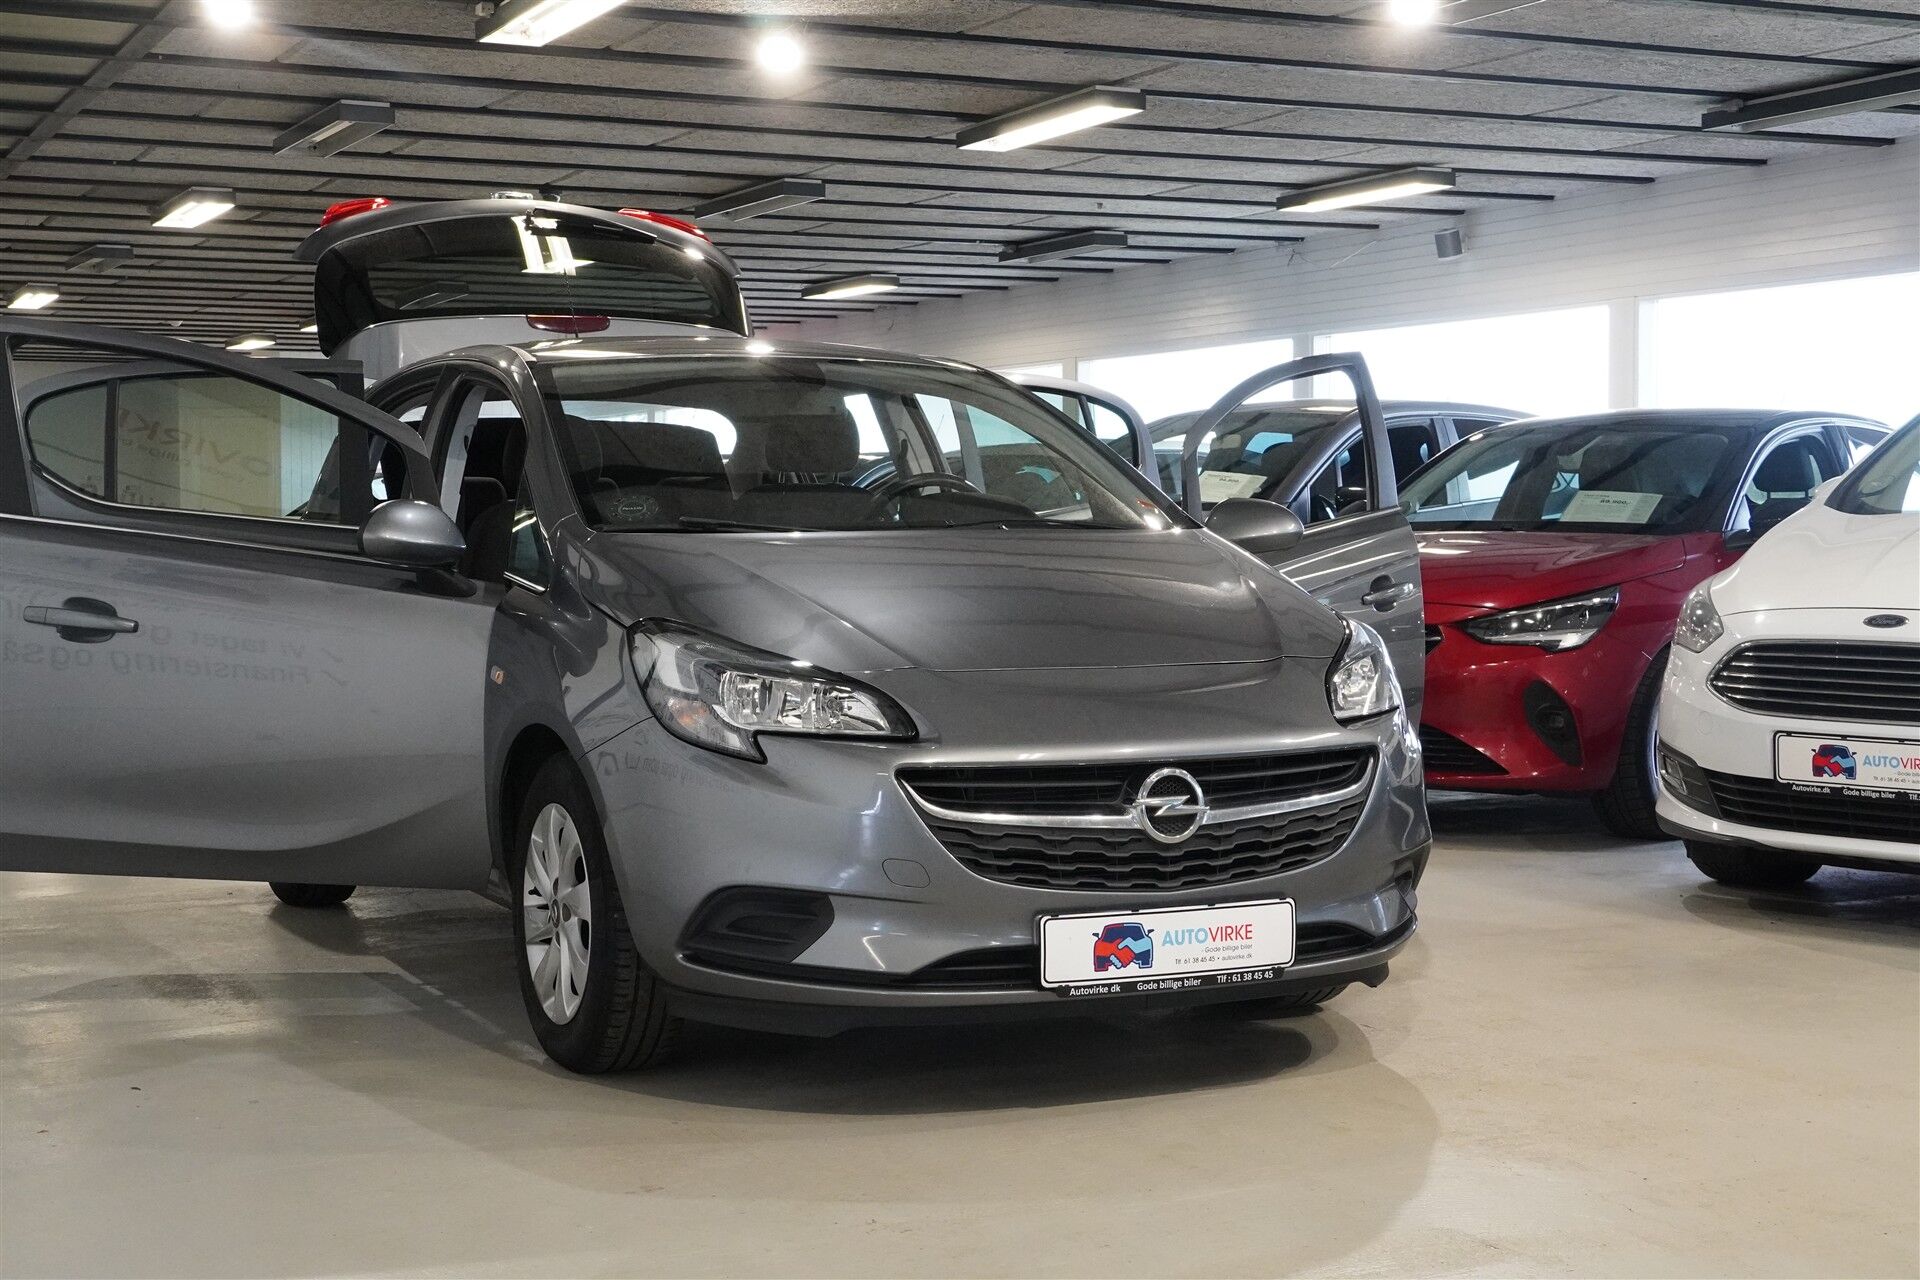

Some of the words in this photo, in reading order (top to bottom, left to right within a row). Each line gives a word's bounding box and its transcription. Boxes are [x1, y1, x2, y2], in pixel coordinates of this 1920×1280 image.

[1791, 784, 1831, 794] Autovirke.dk
[1842, 788, 1860, 797] Gode
[1861, 790, 1880, 798] billige
[1881, 791, 1896, 799] biler
[1161, 923, 1253, 947] AUTOVIRKE
[1222, 944, 1239, 952] billige
[1136, 981, 1158, 991] Gode
[1159, 978, 1183, 990] billige
[1184, 977, 1202, 987] biler
[1232, 973, 1242, 982] 61
[1243, 972, 1252, 981] 38
[1253, 971, 1263, 980] 45
[1263, 970, 1274, 979] 45
